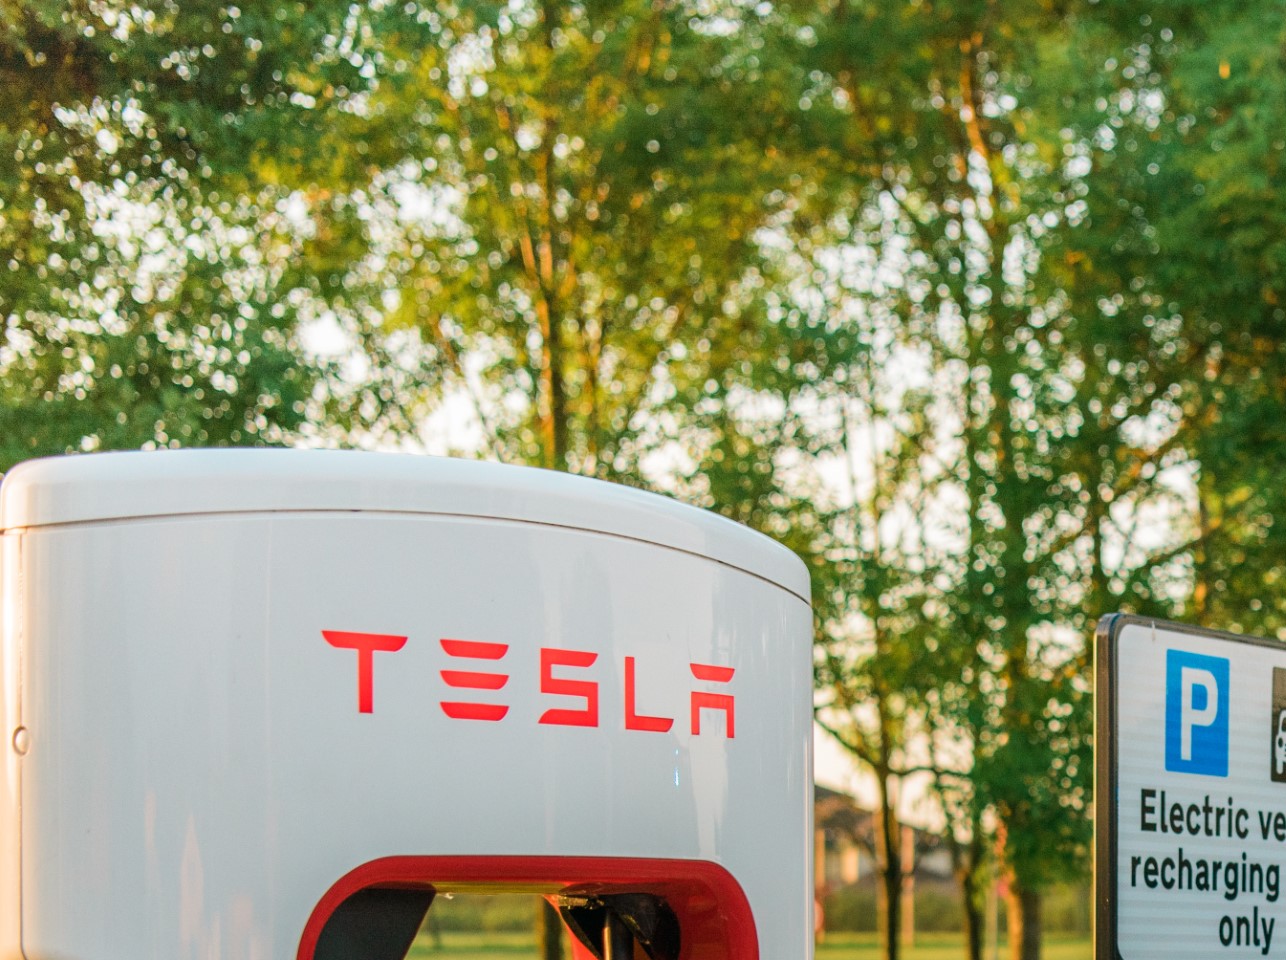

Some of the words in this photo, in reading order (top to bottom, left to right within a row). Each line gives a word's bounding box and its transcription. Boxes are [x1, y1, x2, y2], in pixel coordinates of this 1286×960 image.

[320, 629, 735, 738] TESLA
[1180, 665, 1219, 761] P
[1140, 788, 1250, 840] Electric
[1130, 847, 1280, 902] recharging
[1218, 905, 1276, 956] only
